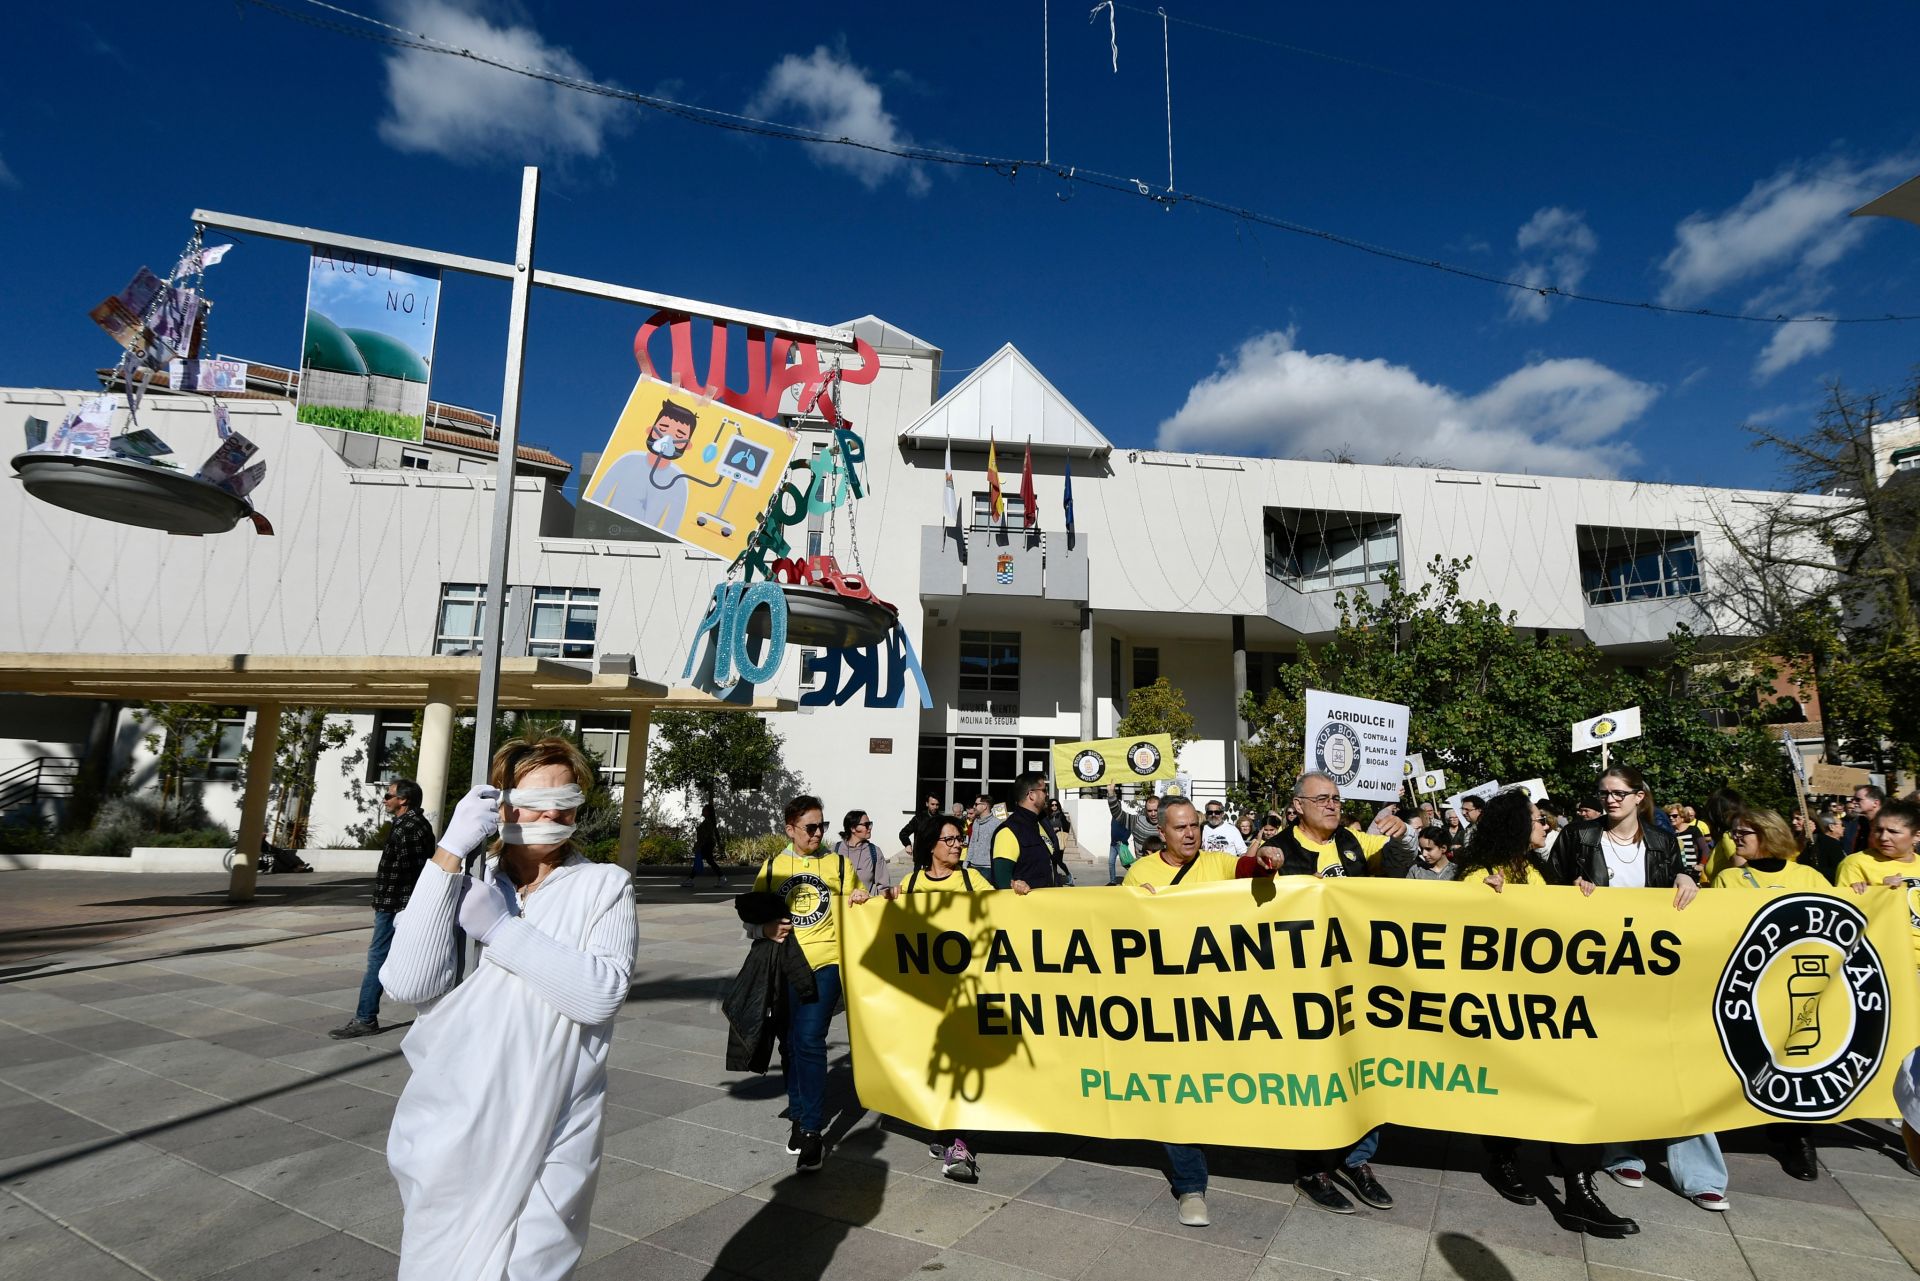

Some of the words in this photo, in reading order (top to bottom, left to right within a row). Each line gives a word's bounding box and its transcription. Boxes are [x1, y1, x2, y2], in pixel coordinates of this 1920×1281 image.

[960, 716, 983, 725] MOLINA
[984, 717, 992, 725] DE
[994, 717, 1017, 726] SEGURA
[1327, 709, 1385, 727] AGRIDULCE
[1388, 718, 1395, 728] II
[1316, 727, 1331, 756] STOP
[1363, 732, 1388, 742] CONTRA
[1364, 746, 1389, 755] PLANTA
[1366, 758, 1389, 767] BIOGAS
[1380, 782, 1397, 792] NO!!
[895, 930, 972, 975] NO
[984, 929, 1022, 973] A
[1031, 928, 1101, 974] LA
[1110, 917, 1353, 976] PLANTA
[1368, 919, 1447, 970] DE
[1460, 917, 1682, 976] BIOGÁS
[1724, 922, 1781, 1021] STOP
[976, 993, 1045, 1036] EN
[1054, 993, 1283, 1043] MOLINA
[1292, 984, 1356, 1041] DE
[1365, 984, 1599, 1041] SEGURA
[1080, 1067, 1348, 1107] PLATAFORMA
[1347, 1056, 1499, 1097] VECINAL
[1751, 1050, 1872, 1106] MOLINA
